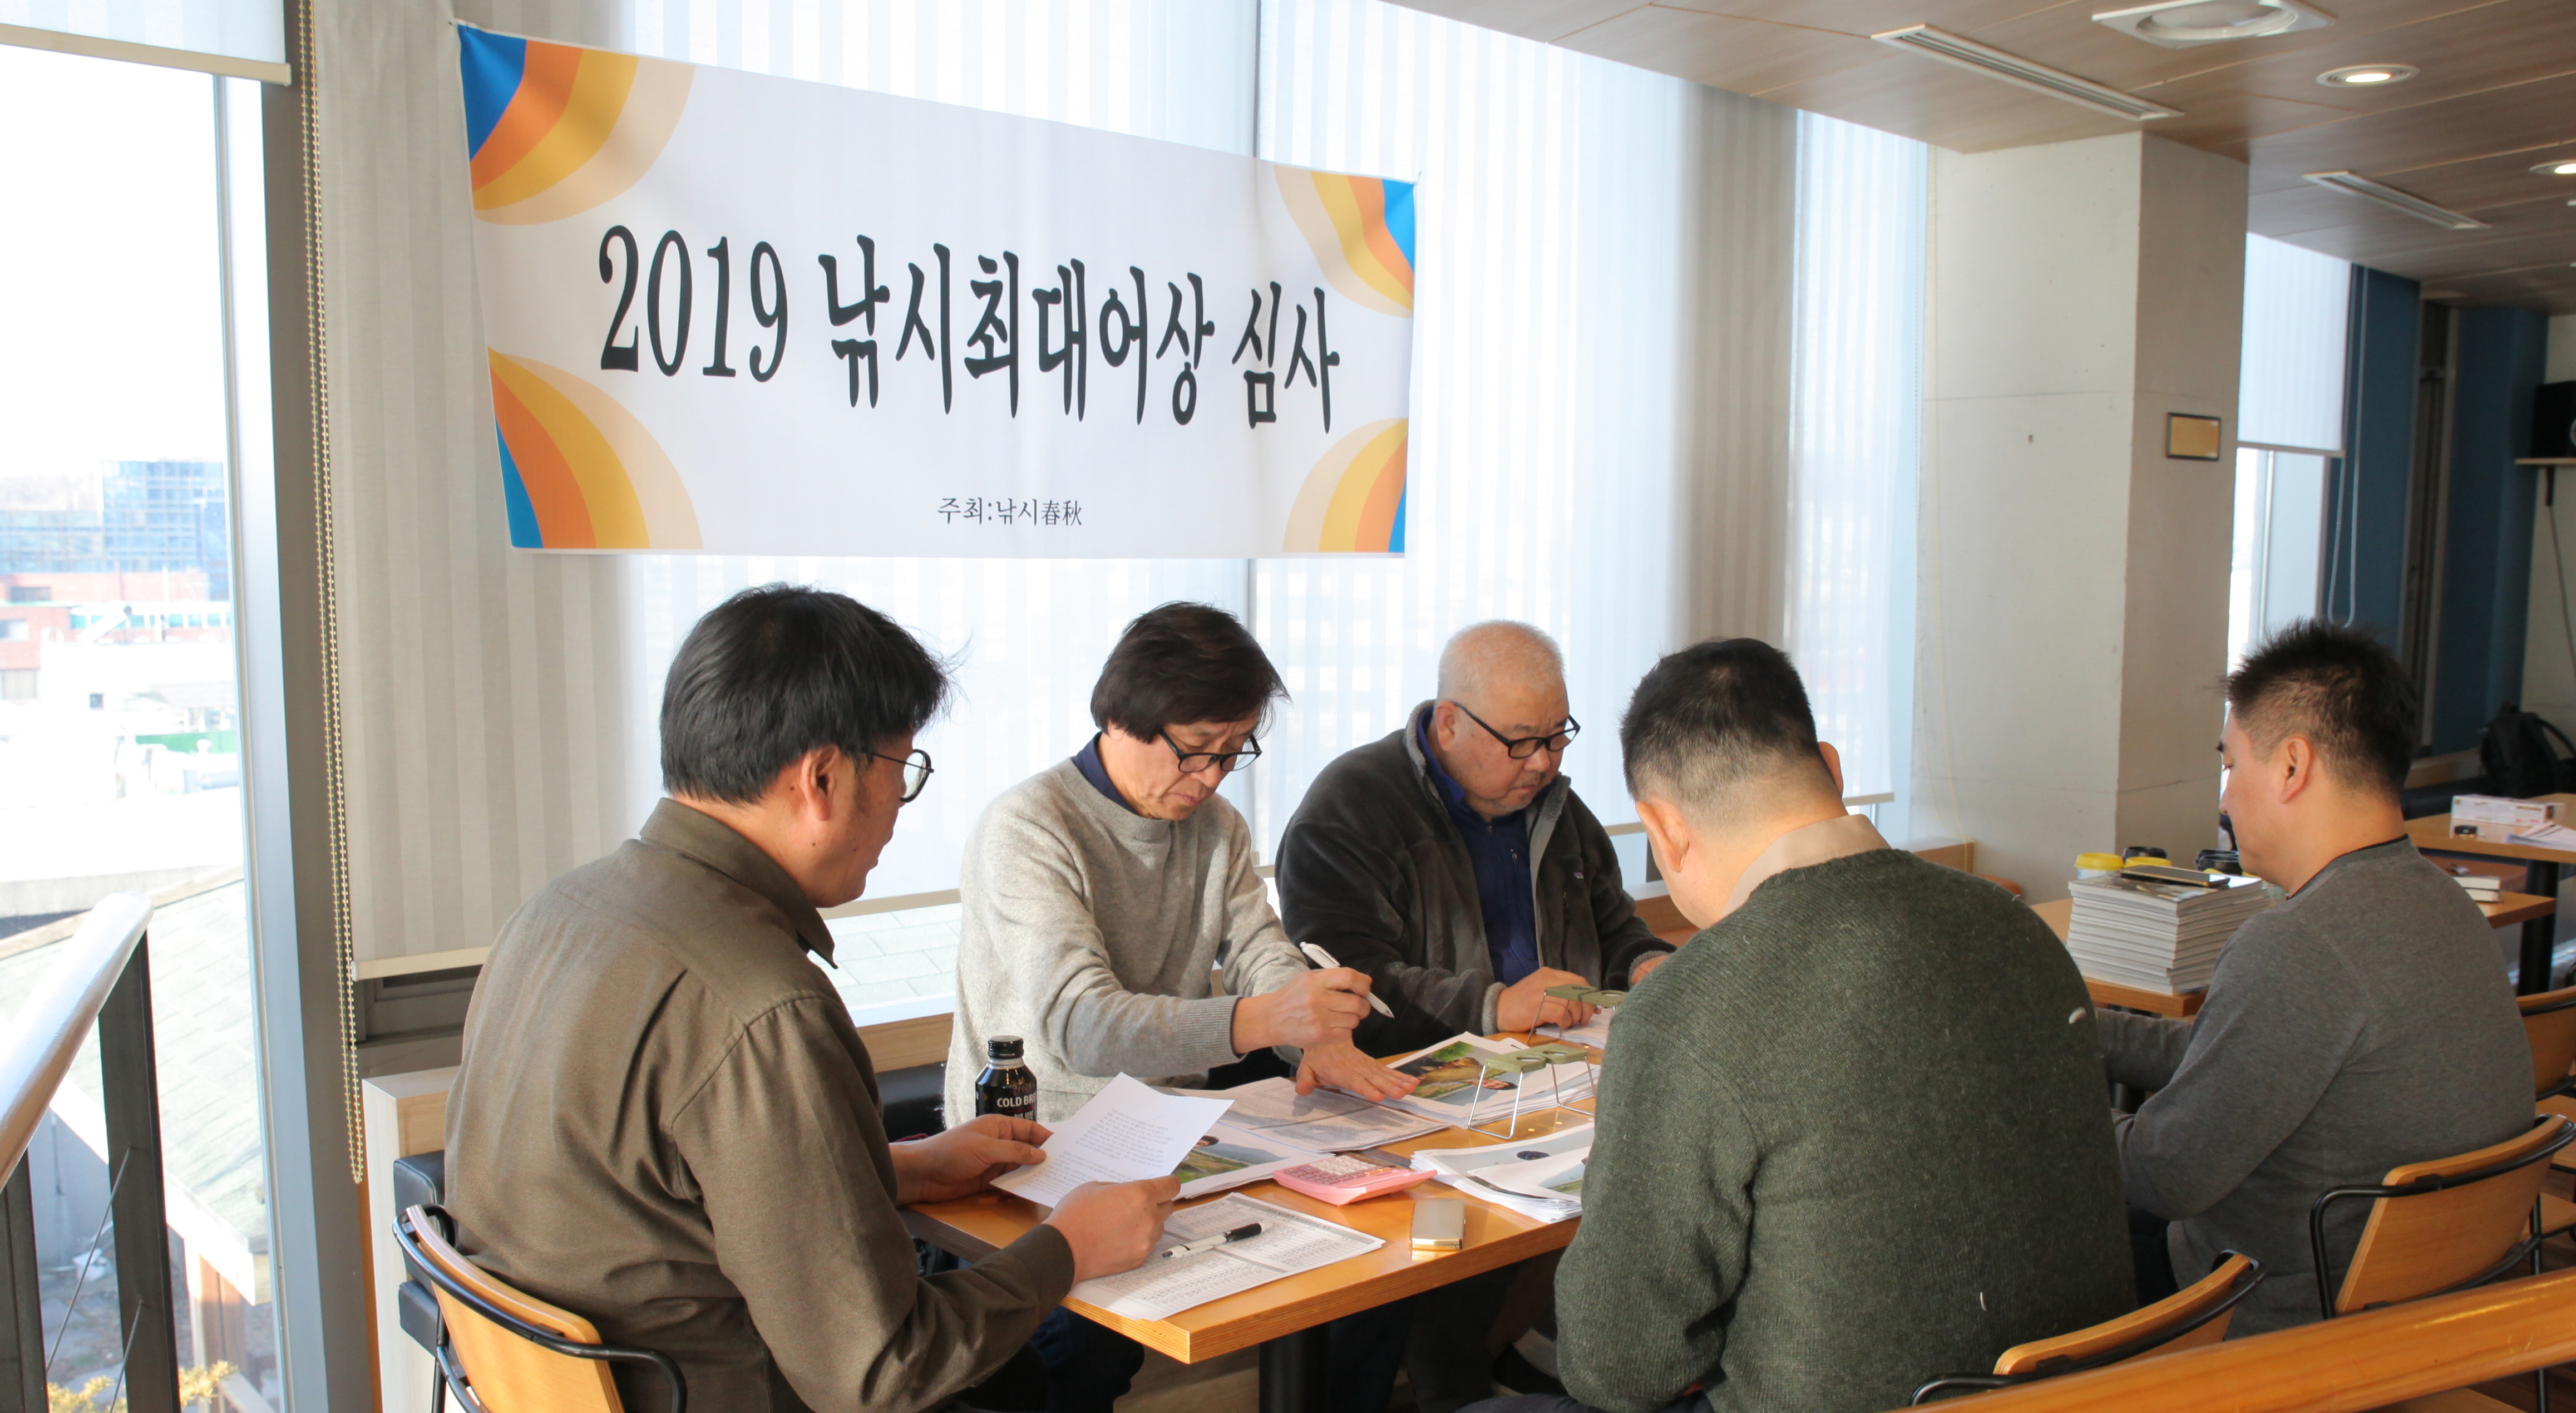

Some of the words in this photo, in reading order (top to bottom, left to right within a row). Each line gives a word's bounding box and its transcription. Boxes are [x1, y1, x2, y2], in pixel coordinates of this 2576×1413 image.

[599, 225, 788, 383] 2019
[818, 234, 1215, 426] 낚시최대어상
[1231, 281, 1340, 434] 심사
[937, 497, 1082, 526] 주최:낚시春秋
[996, 1097, 1021, 1107] COLD
[1023, 1094, 1037, 1105] BRE
